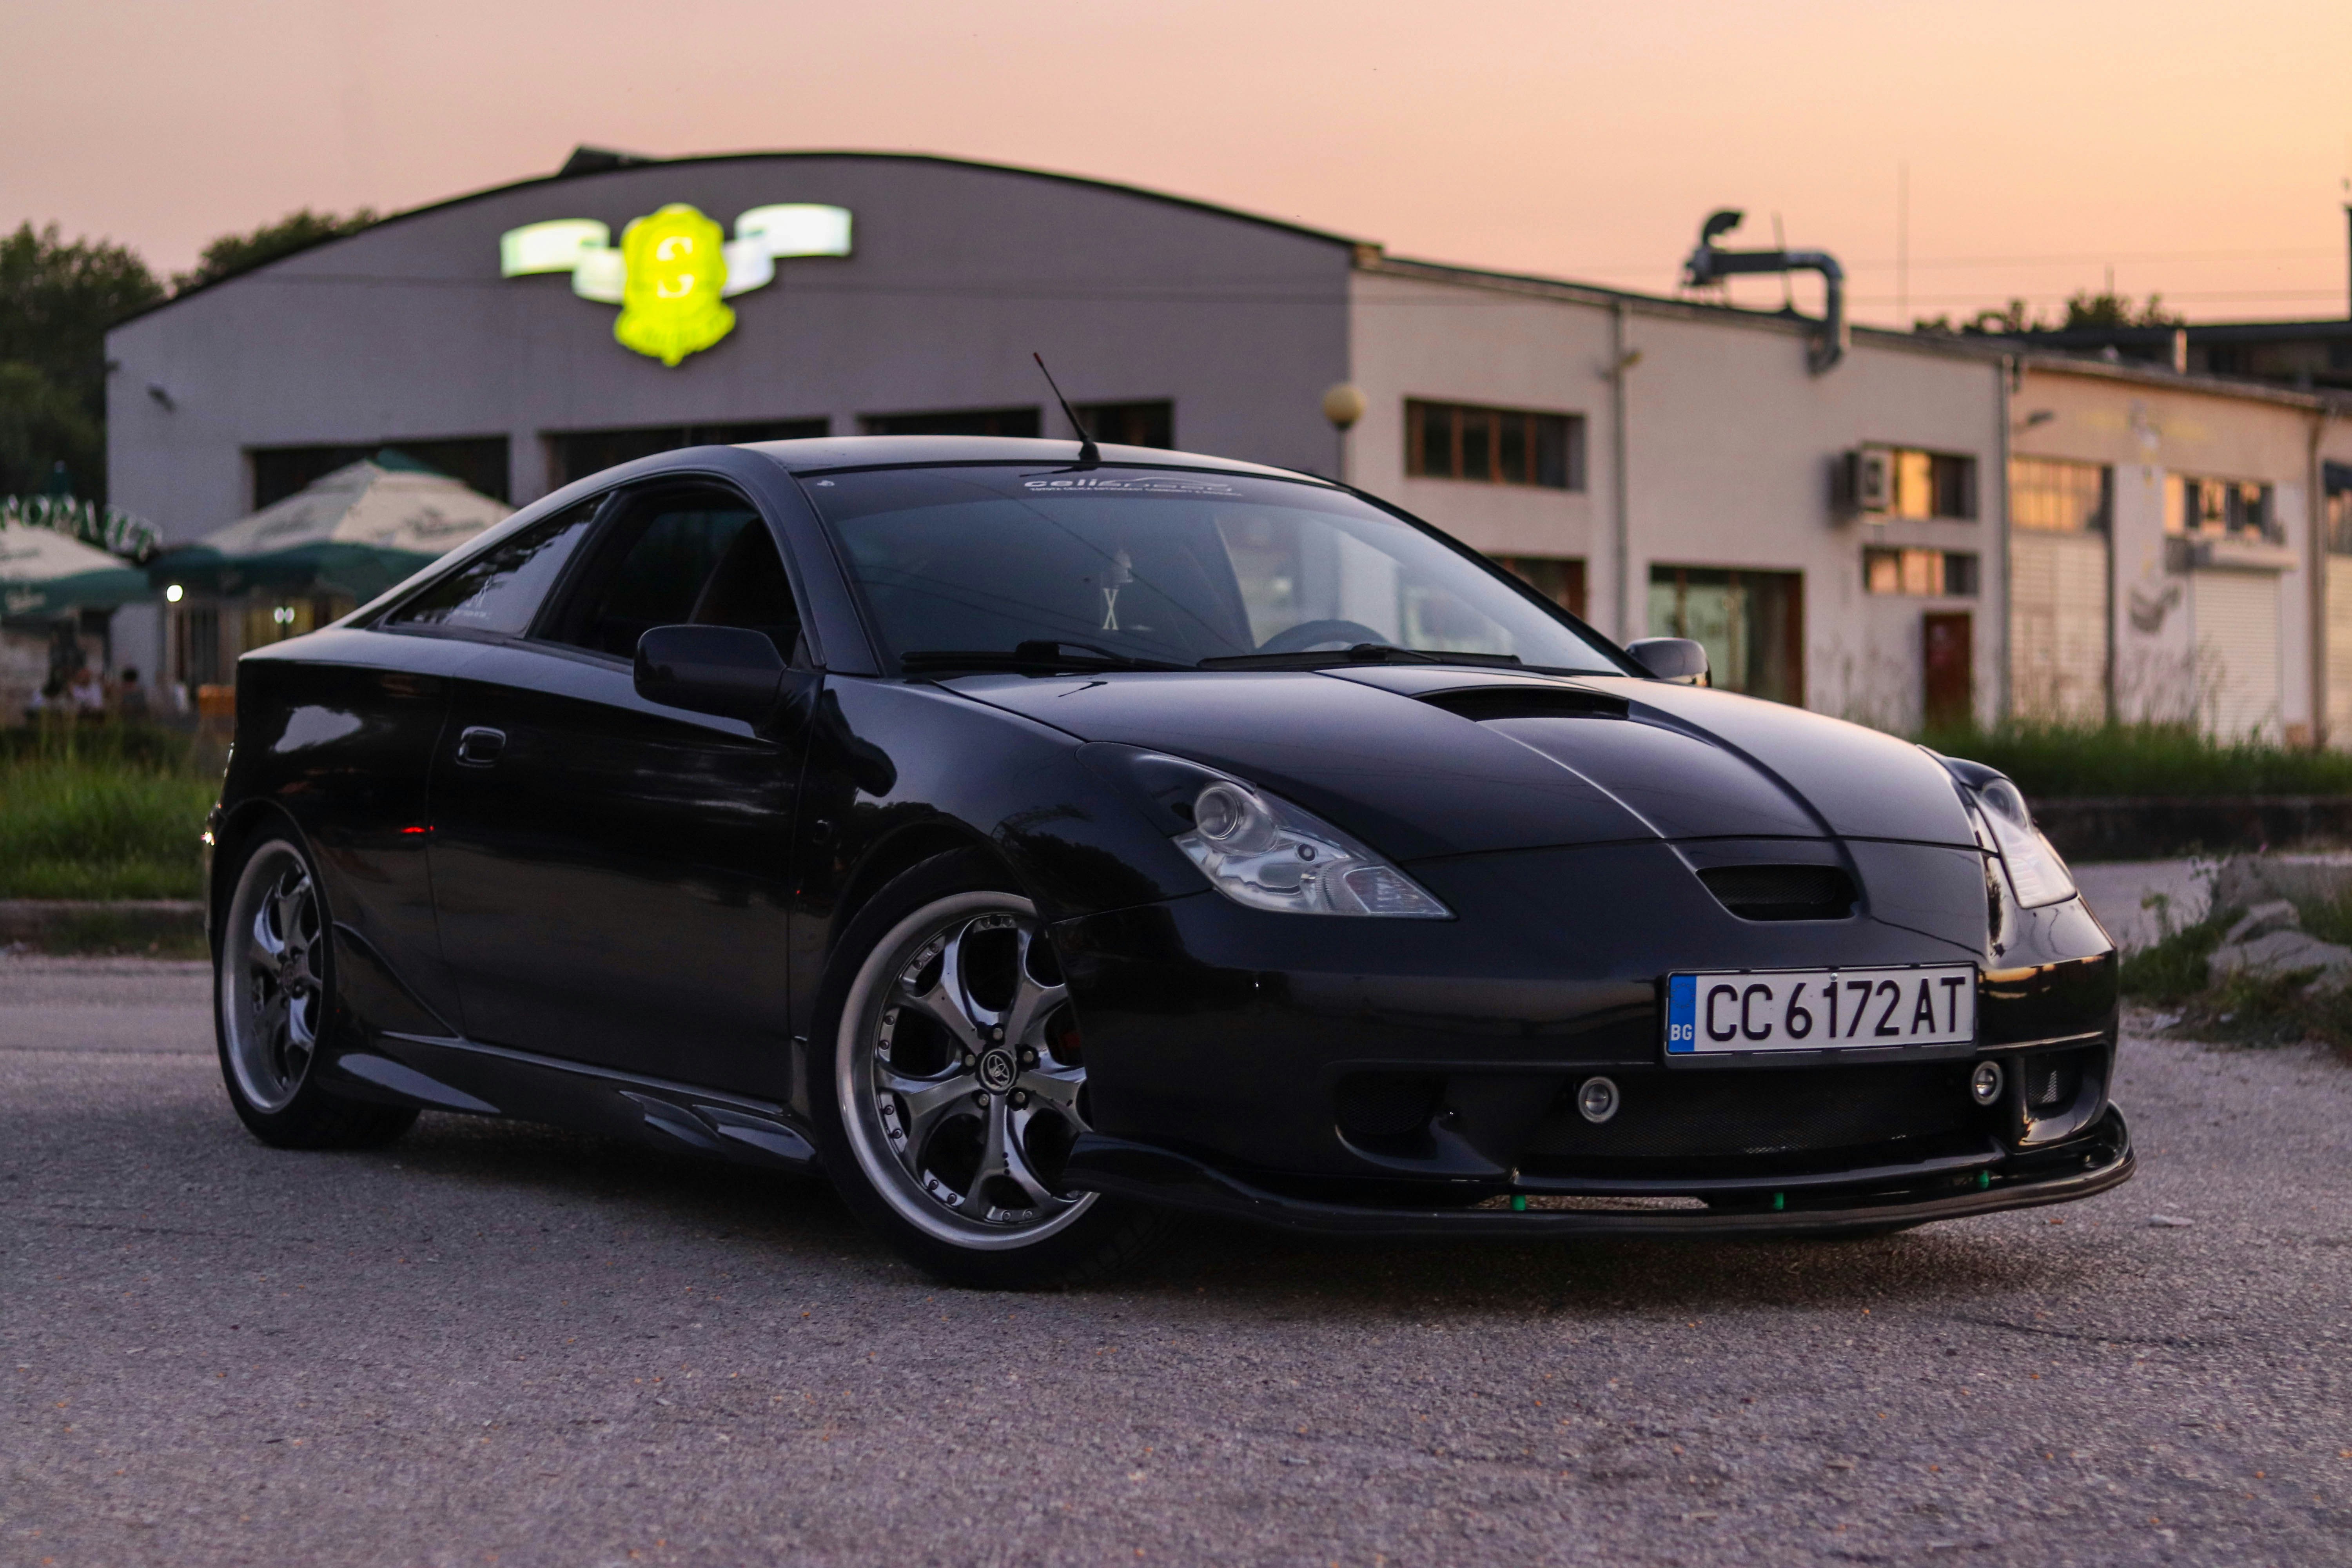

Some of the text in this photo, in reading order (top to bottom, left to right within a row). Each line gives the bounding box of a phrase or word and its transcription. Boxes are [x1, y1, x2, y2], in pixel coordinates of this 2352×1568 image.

[1706, 976, 1965, 1042] CC 6172 AT
[1671, 1024, 1693, 1041] BG
